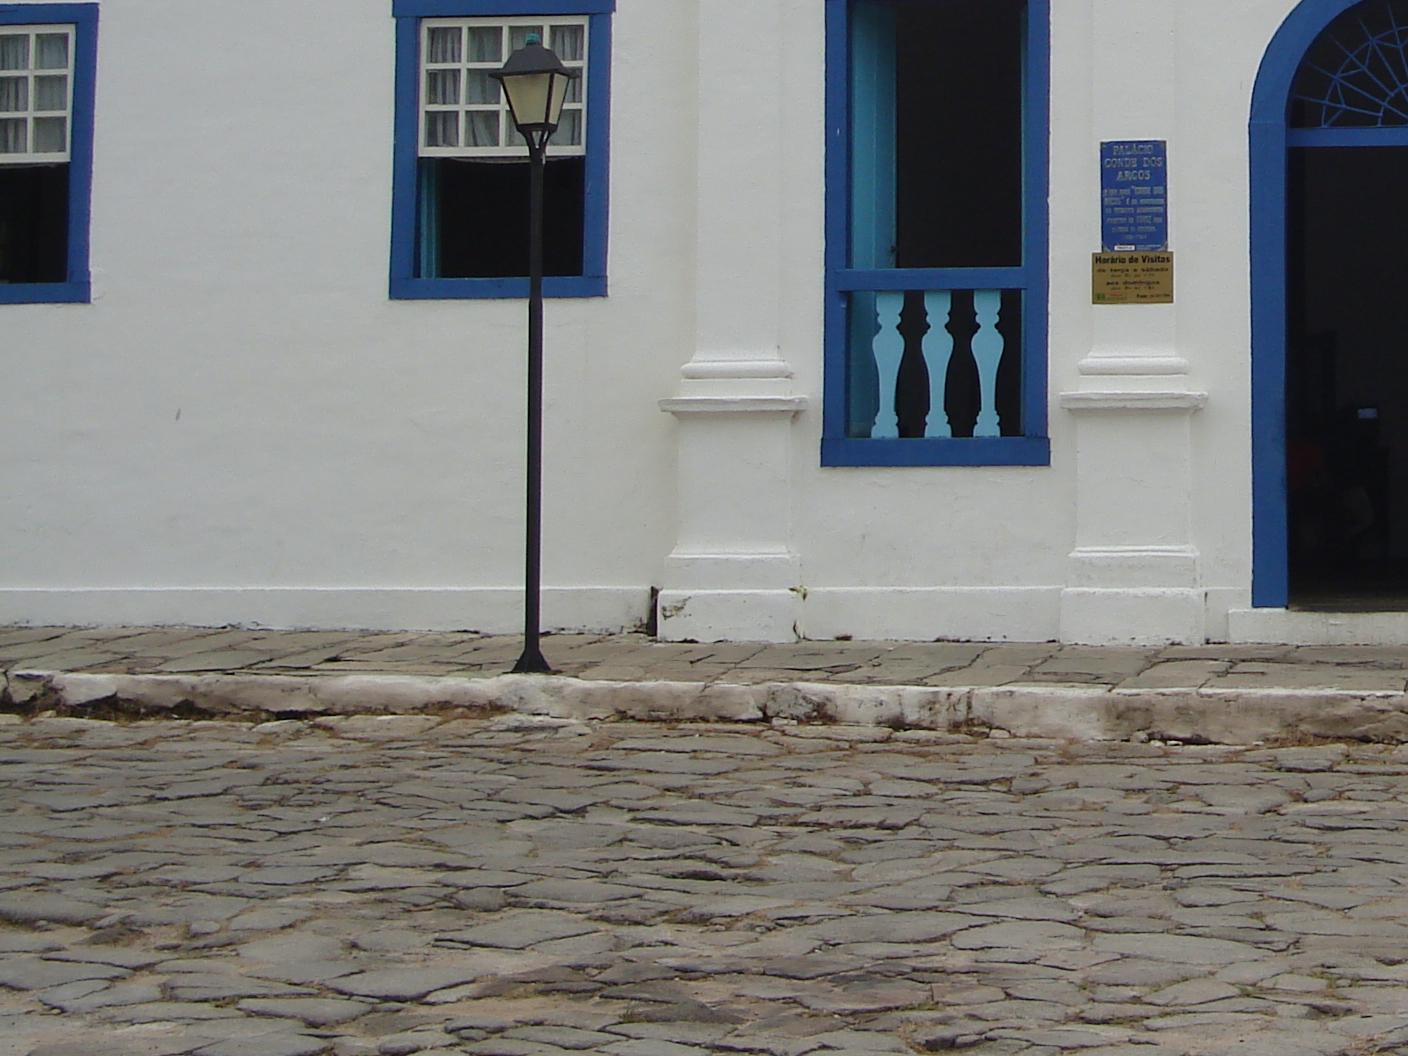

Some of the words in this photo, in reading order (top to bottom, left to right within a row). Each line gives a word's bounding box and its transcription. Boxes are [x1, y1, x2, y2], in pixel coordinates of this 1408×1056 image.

[1104, 157, 1137, 168] CONDE
[1142, 156, 1163, 168] DOS
[1095, 255, 1127, 264] Horário
[1128, 255, 1139, 264] de
[1141, 255, 1171, 264] Visitas
